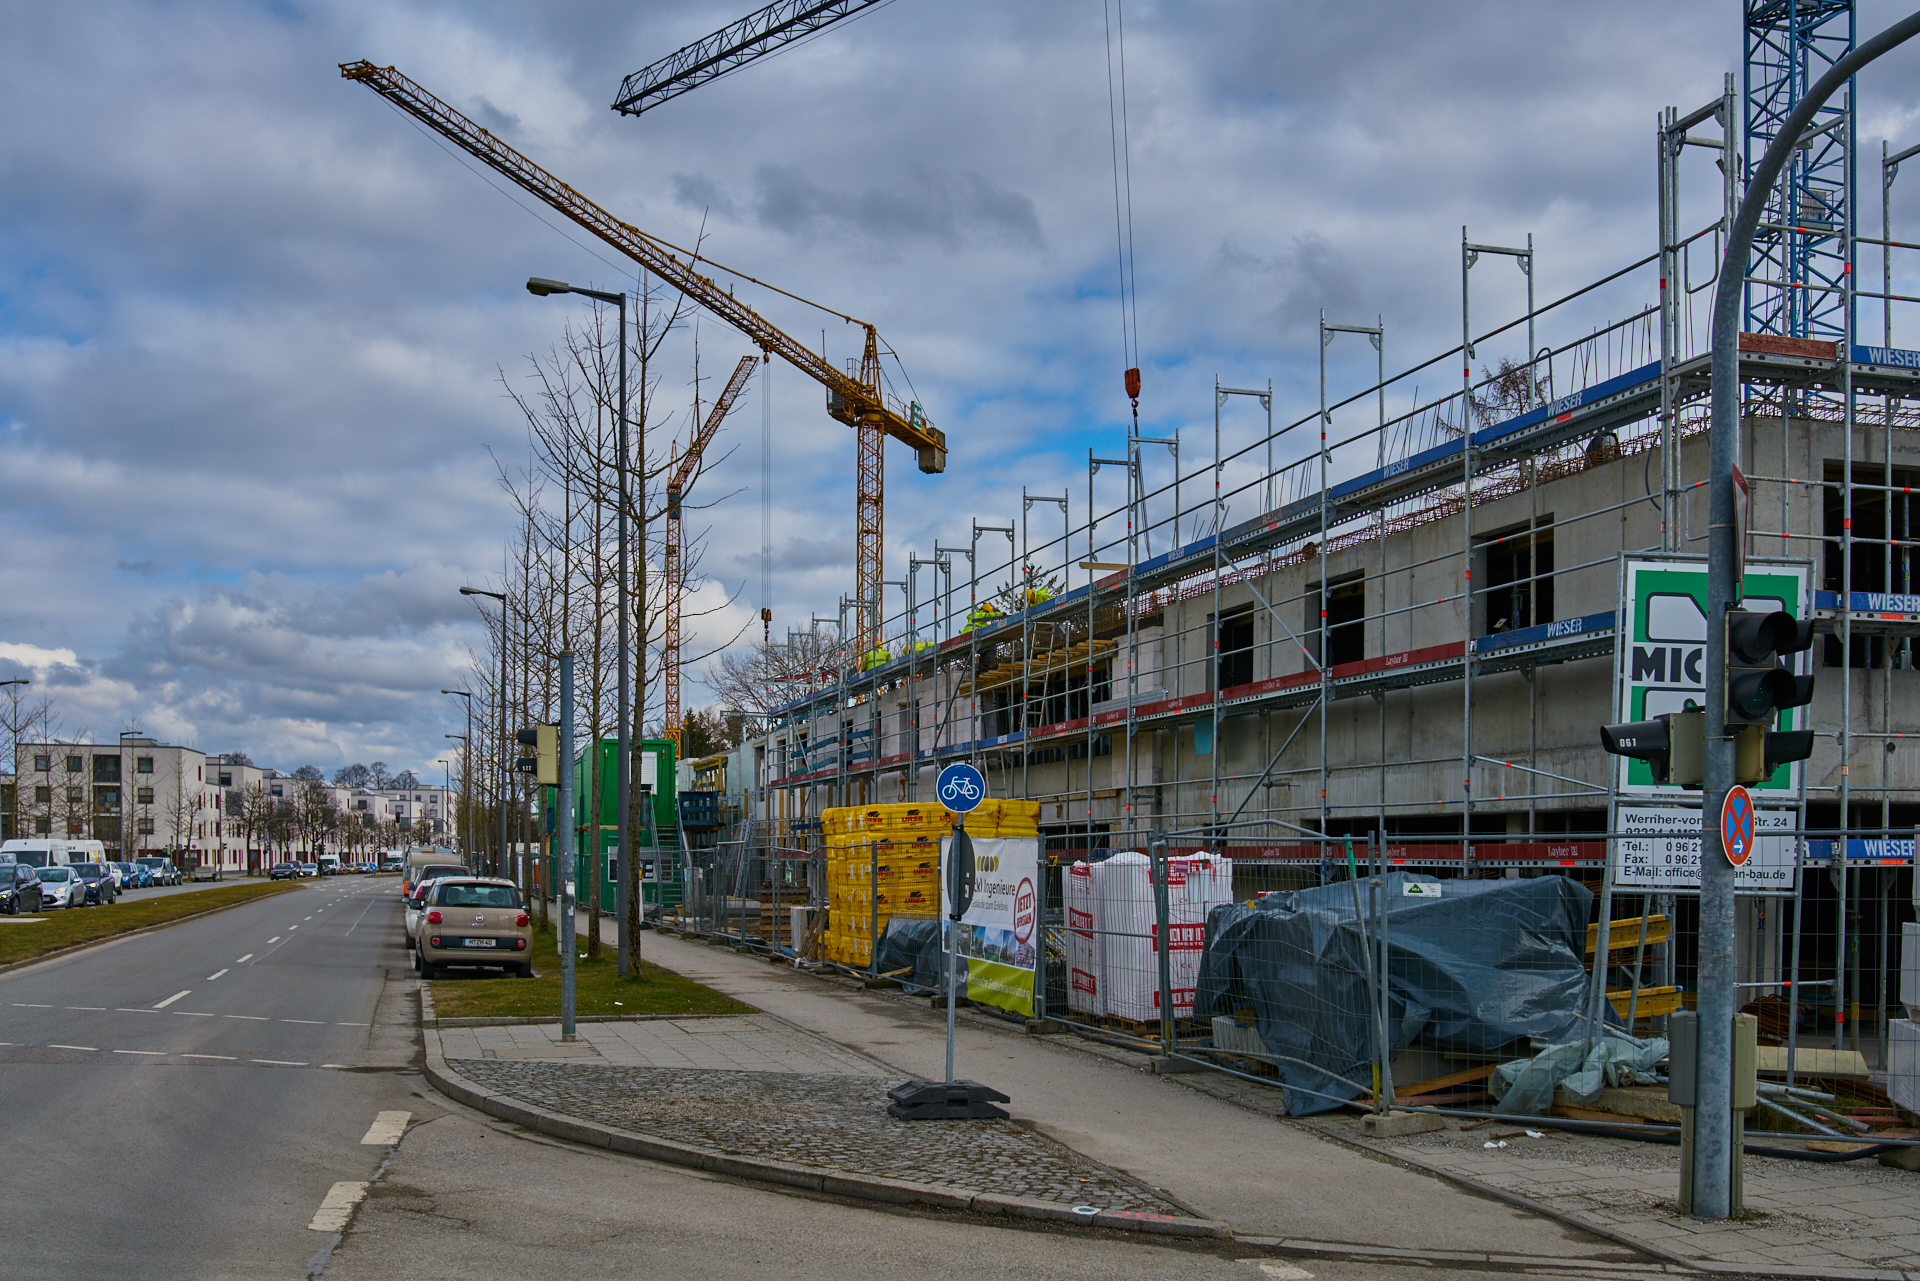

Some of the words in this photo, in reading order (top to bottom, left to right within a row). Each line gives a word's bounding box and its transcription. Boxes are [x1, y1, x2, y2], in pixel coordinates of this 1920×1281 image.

[1867, 347, 1920, 367] WIESER
[1547, 391, 1582, 417] WIESER
[1383, 459, 1409, 478] WIESER
[1868, 593, 1920, 612] WIESER
[1547, 618, 1582, 637] WIESER
[1632, 646, 1703, 684] MIC
[1620, 738, 1636, 747] 061
[1774, 818, 1787, 827] 24
[1548, 846, 1569, 858] Layher
[1625, 841, 1649, 851] Tel.:
[1675, 842, 1688, 852] 96
[1624, 854, 1648, 864] Fax:
[1674, 855, 1687, 864] 96
[1624, 866, 1662, 876] E-Mail:
[983, 878, 1016, 898] Ingenieure
[1017, 892, 1031, 913] JETZT
[1169, 927, 1204, 942] ORI
